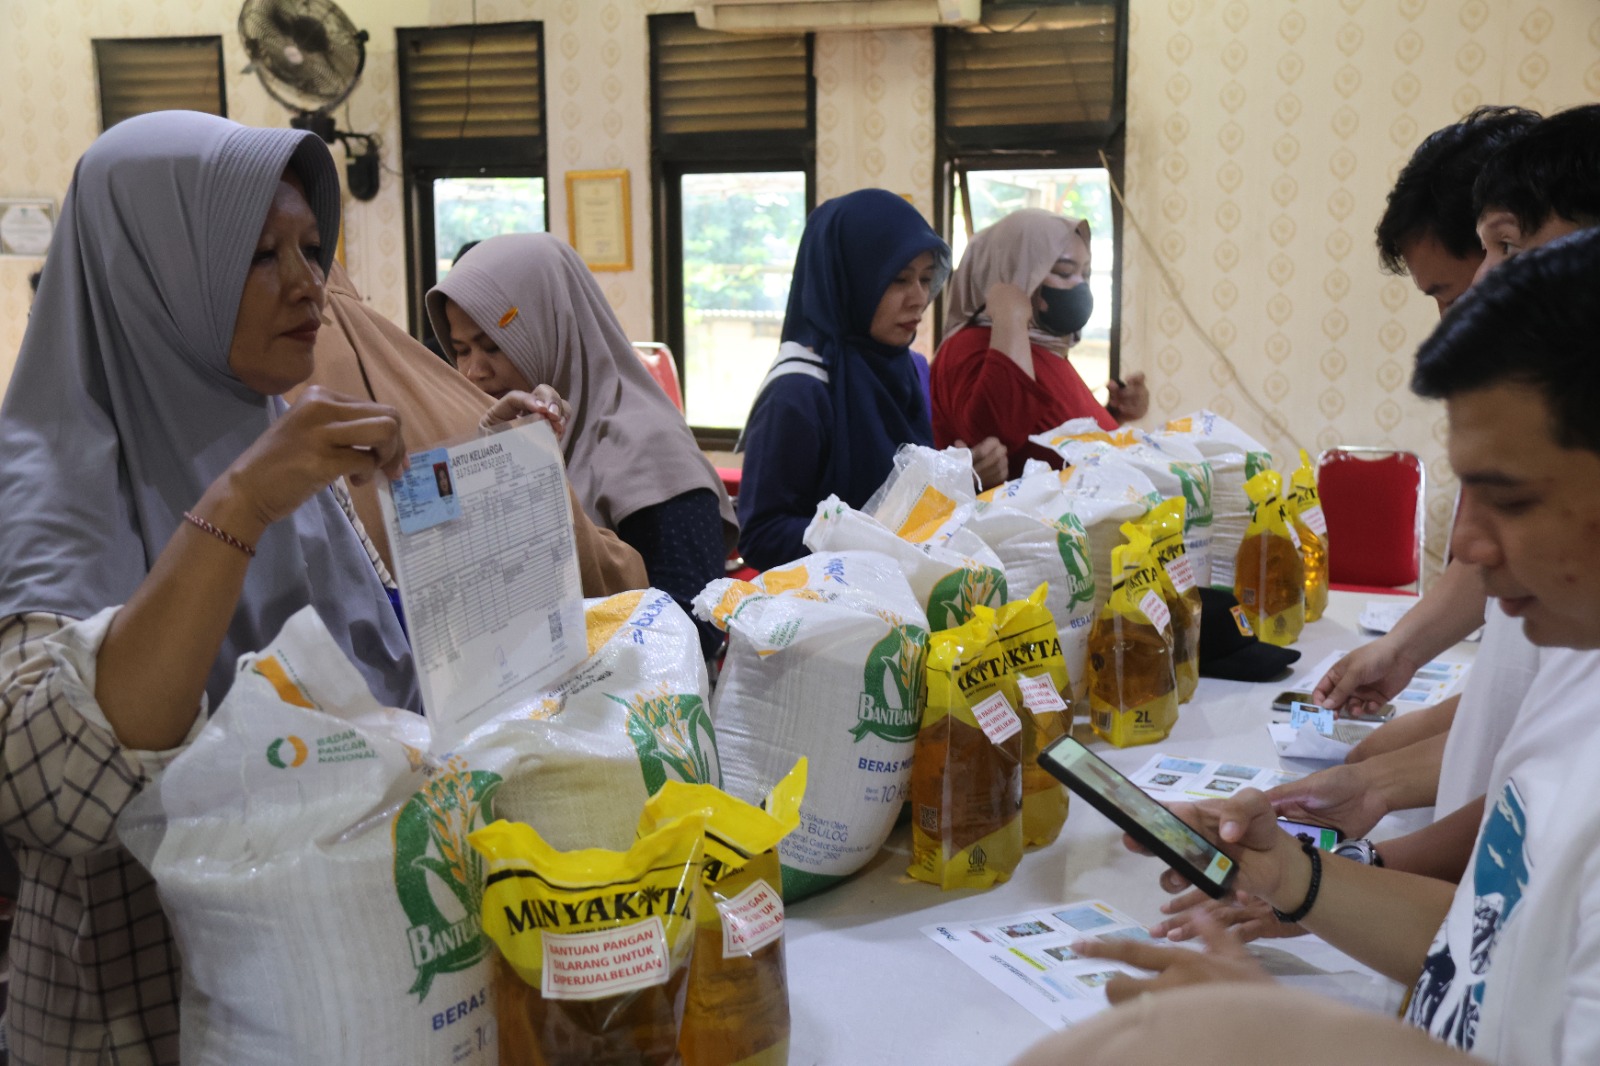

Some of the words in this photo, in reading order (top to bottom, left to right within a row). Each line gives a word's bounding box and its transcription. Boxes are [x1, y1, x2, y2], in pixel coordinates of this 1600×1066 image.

[451, 453, 469, 467] ARTU
[469, 443, 504, 462] KELUARGA
[1070, 612, 1094, 629] BERA
[858, 692, 914, 726] BANTUAN
[1134, 711, 1152, 723] 2L
[316, 729, 357, 747] BADAN
[857, 757, 899, 773] BERAS
[808, 822, 848, 843] BULOG
[407, 911, 484, 968] BANTUA
[549, 943, 600, 957] BANTUAN
[603, 929, 654, 952] PANGAN
[553, 955, 610, 972] DILARANG
[613, 944, 655, 966] UNTUK
[552, 958, 663, 986] DIPERJUALBELIKAN
